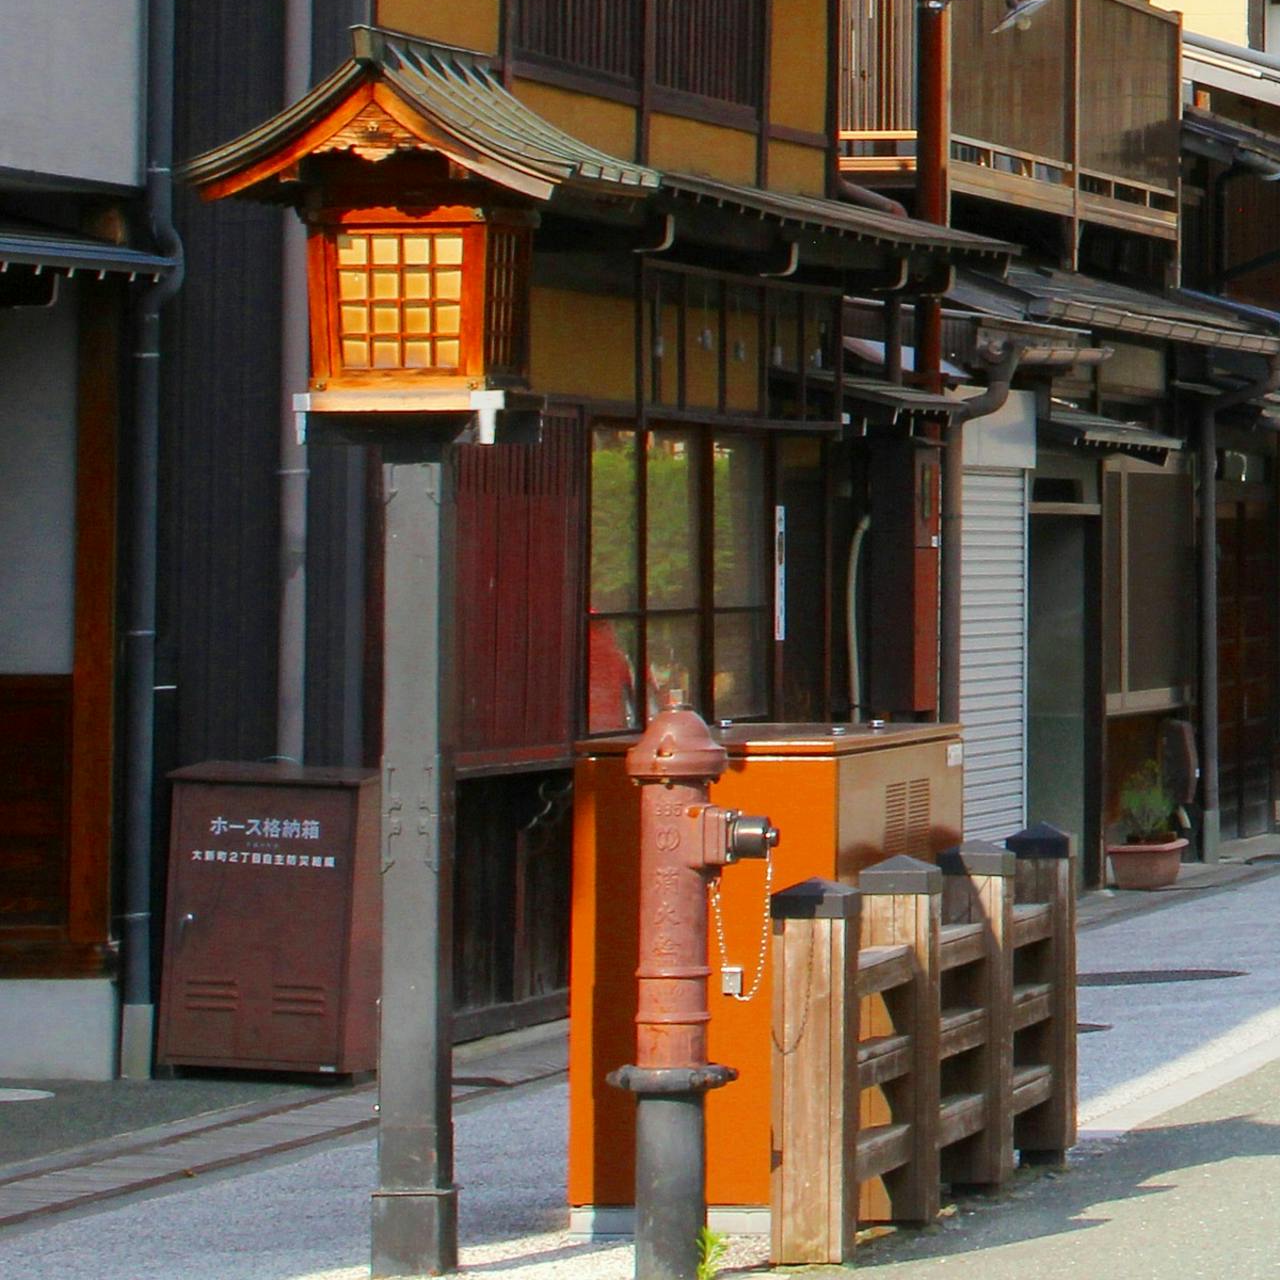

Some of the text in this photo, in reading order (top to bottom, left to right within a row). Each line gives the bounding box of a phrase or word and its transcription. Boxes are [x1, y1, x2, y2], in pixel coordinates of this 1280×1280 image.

[210, 816, 320, 840] ホース格納箱
